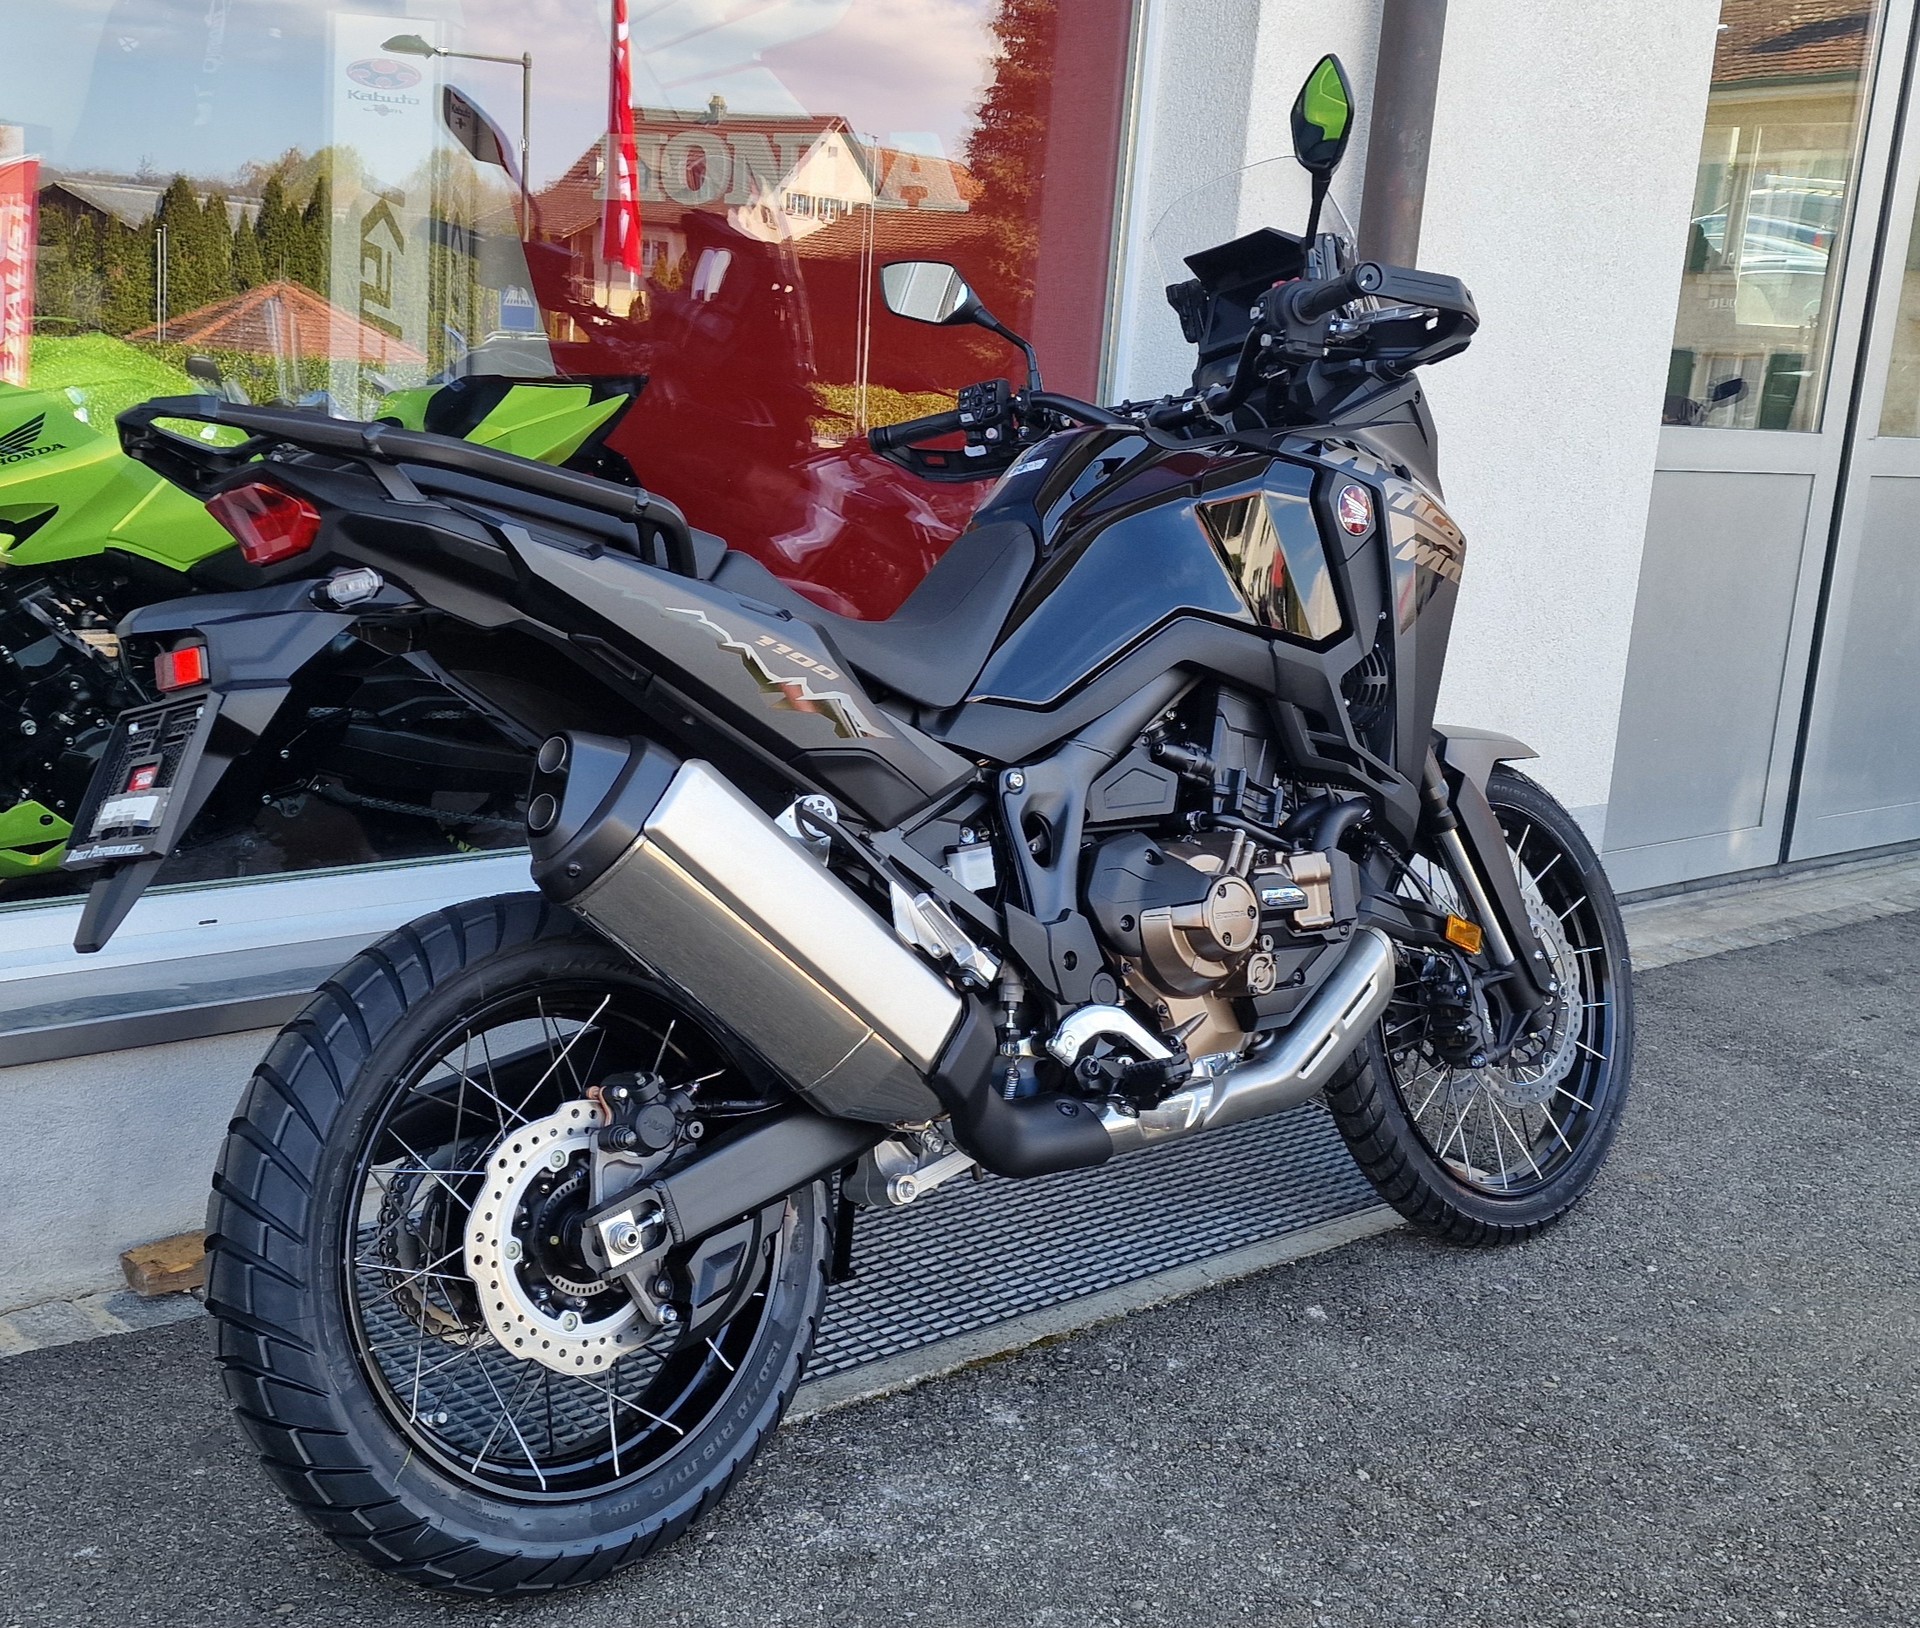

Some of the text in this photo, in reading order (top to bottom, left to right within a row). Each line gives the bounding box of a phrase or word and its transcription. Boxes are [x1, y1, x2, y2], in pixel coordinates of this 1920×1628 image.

[347, 89, 420, 105] Kabuto
[0, 443, 68, 466] HONDA
[754, 634, 840, 681] 1100
